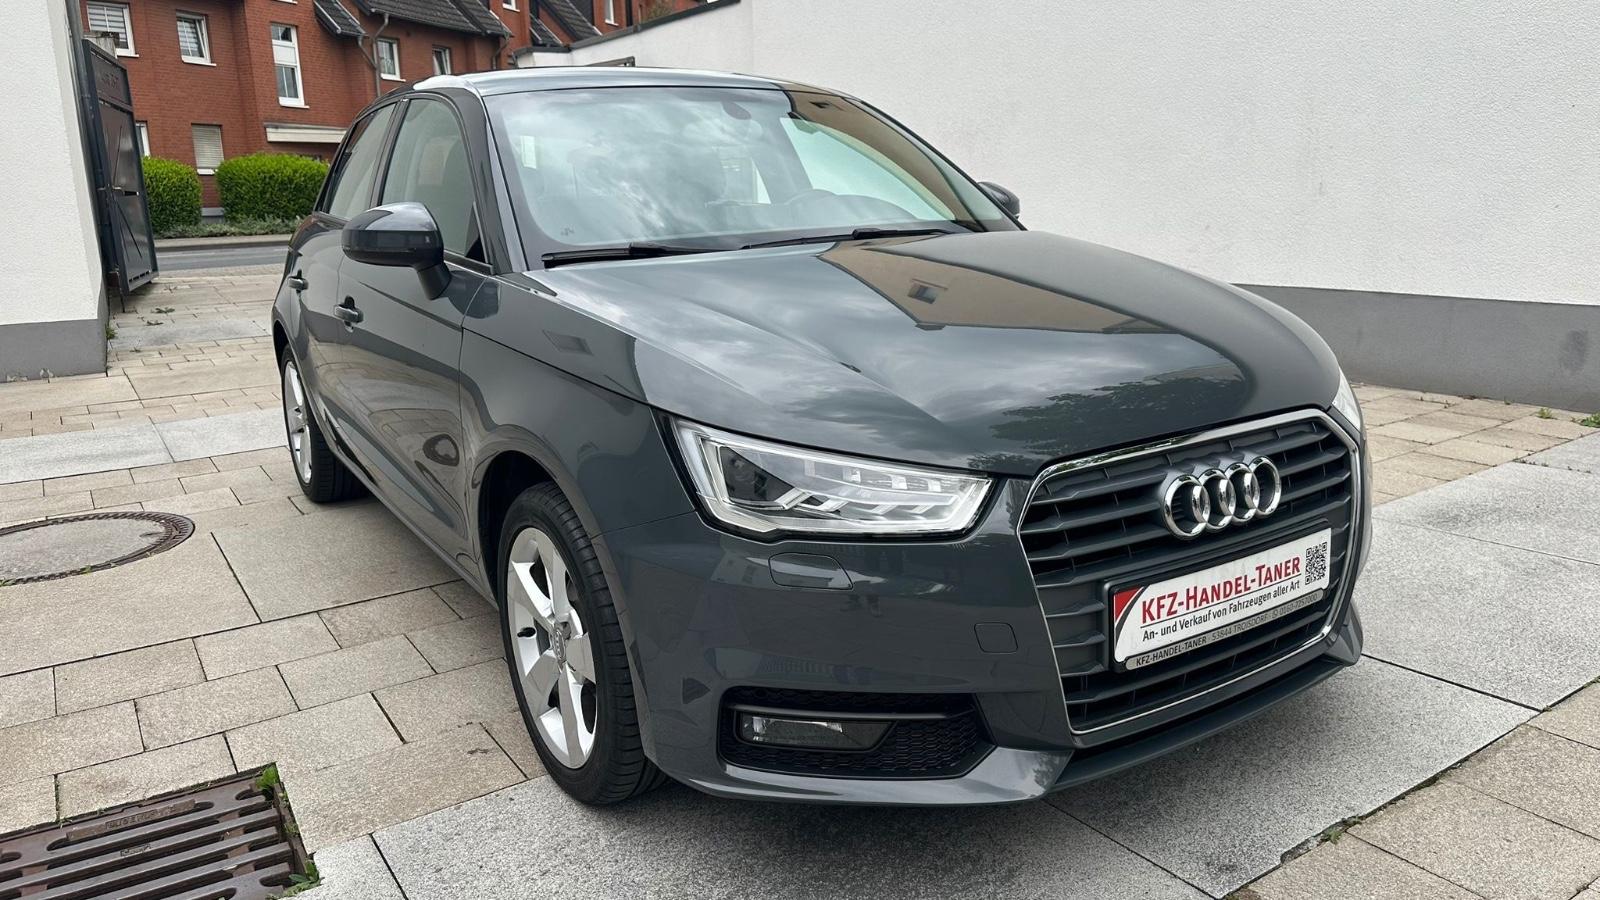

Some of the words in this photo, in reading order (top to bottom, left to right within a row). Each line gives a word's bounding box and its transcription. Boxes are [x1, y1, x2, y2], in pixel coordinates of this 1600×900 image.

[1142, 556, 1302, 624] KFZ-HANDEL-TANER
[1143, 629, 1159, 641] An-
[1161, 621, 1177, 635] und
[1179, 612, 1213, 629] Verkauf
[1213, 607, 1228, 619] von
[1229, 591, 1272, 614] Fahrzeugen
[1273, 586, 1288, 598] aller
[1289, 580, 1300, 592] Art
[1136, 638, 1207, 666] KFZ-HANDEL-TANER
[1212, 628, 1232, 640] 53844
[1234, 614, 1268, 633] TROISDORF
